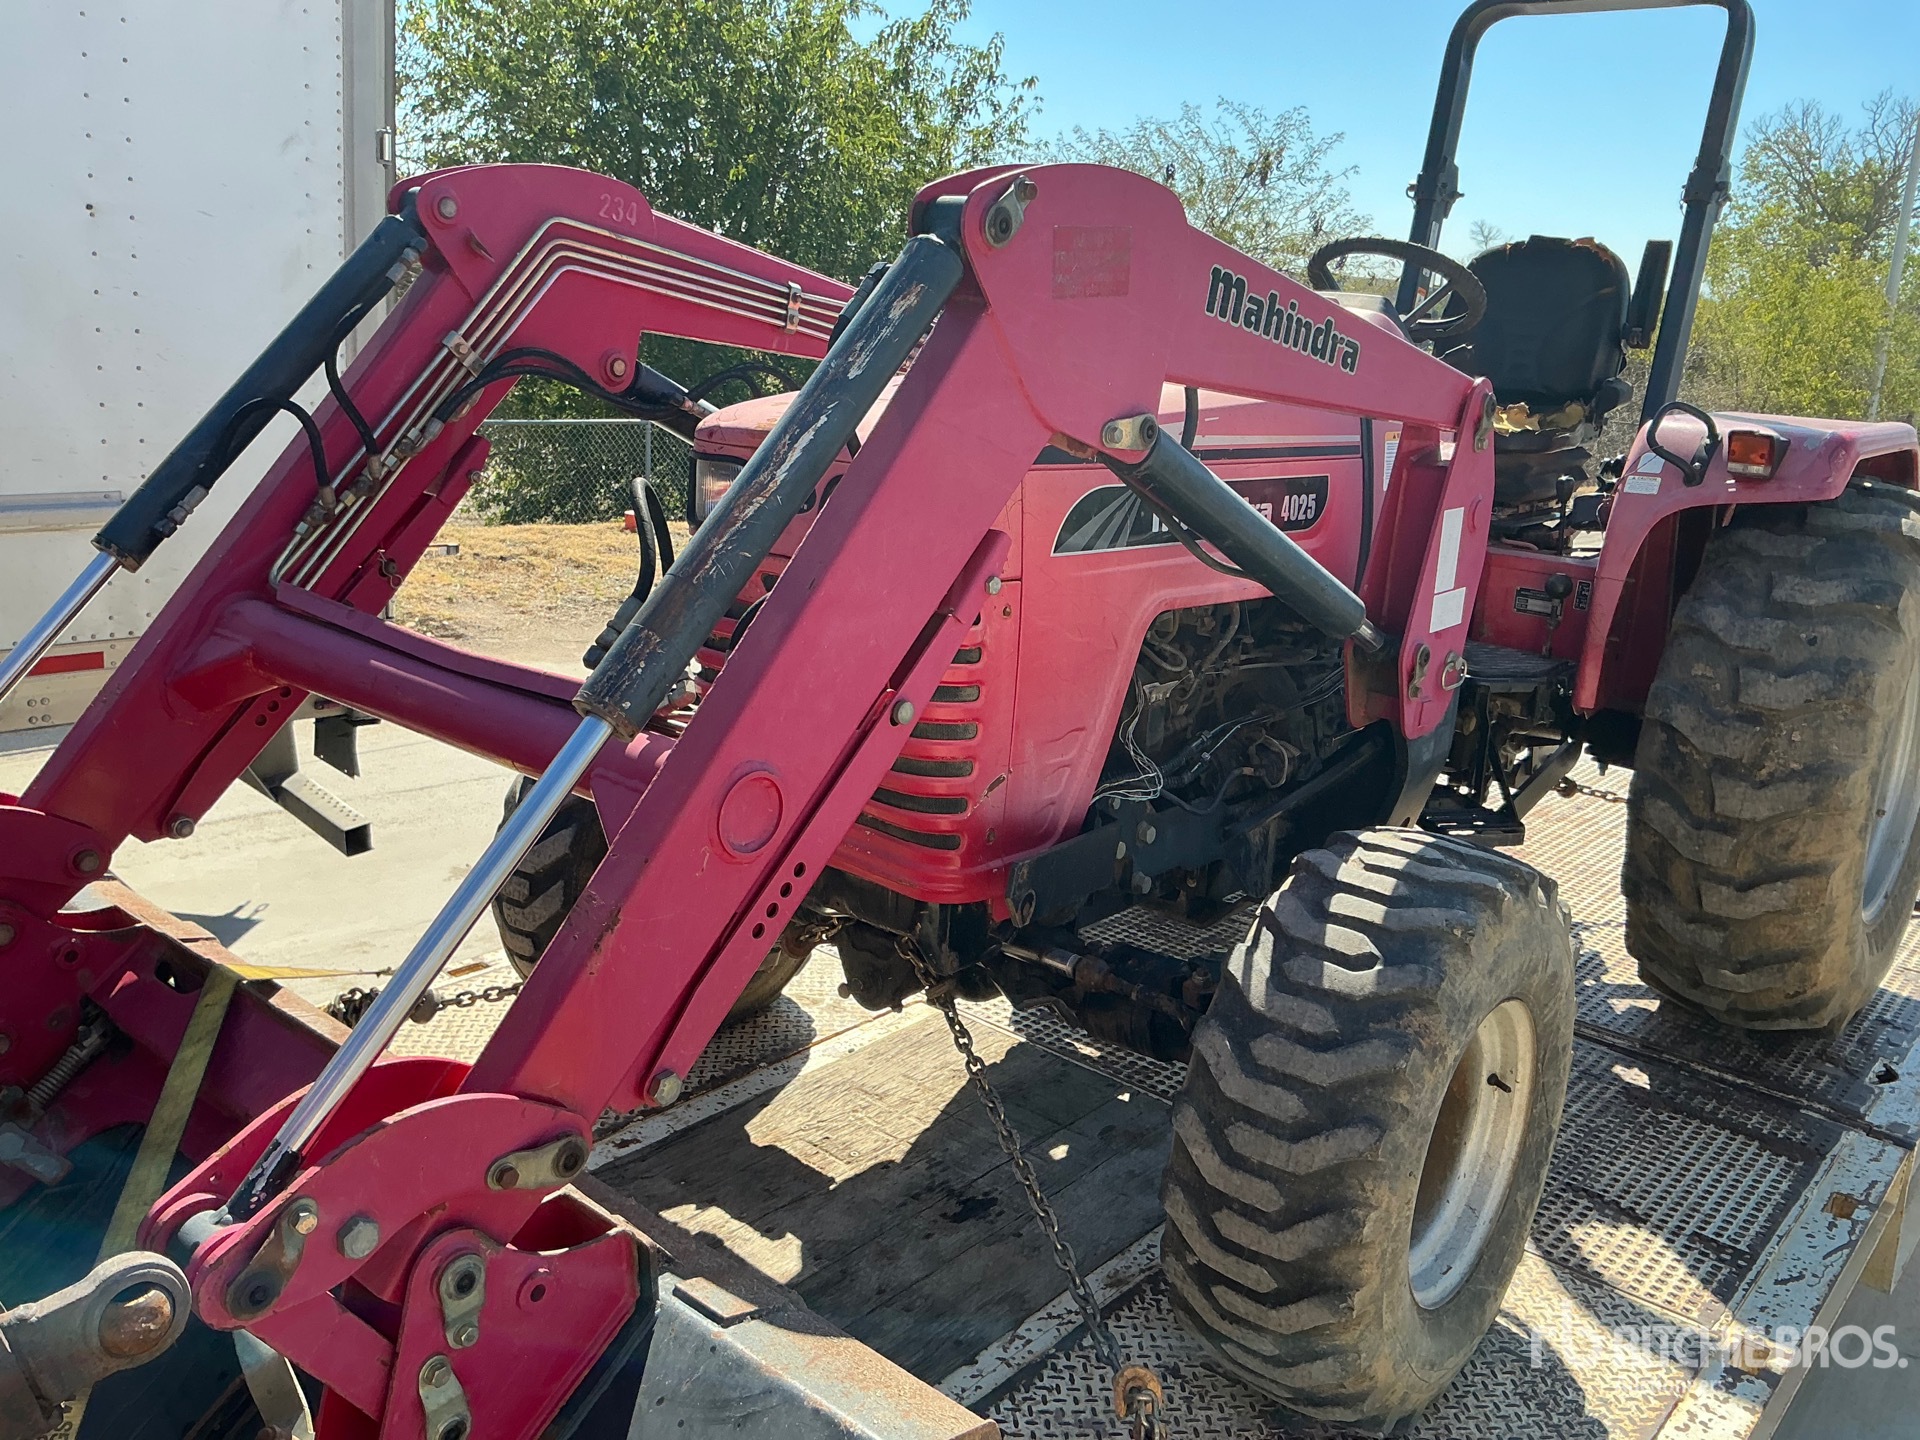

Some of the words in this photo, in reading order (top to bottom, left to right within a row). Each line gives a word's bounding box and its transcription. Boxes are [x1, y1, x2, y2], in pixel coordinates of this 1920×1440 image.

[599, 194, 638, 226] 234
[1205, 264, 1361, 375] Mahindra
[1280, 493, 1317, 523] 4025
